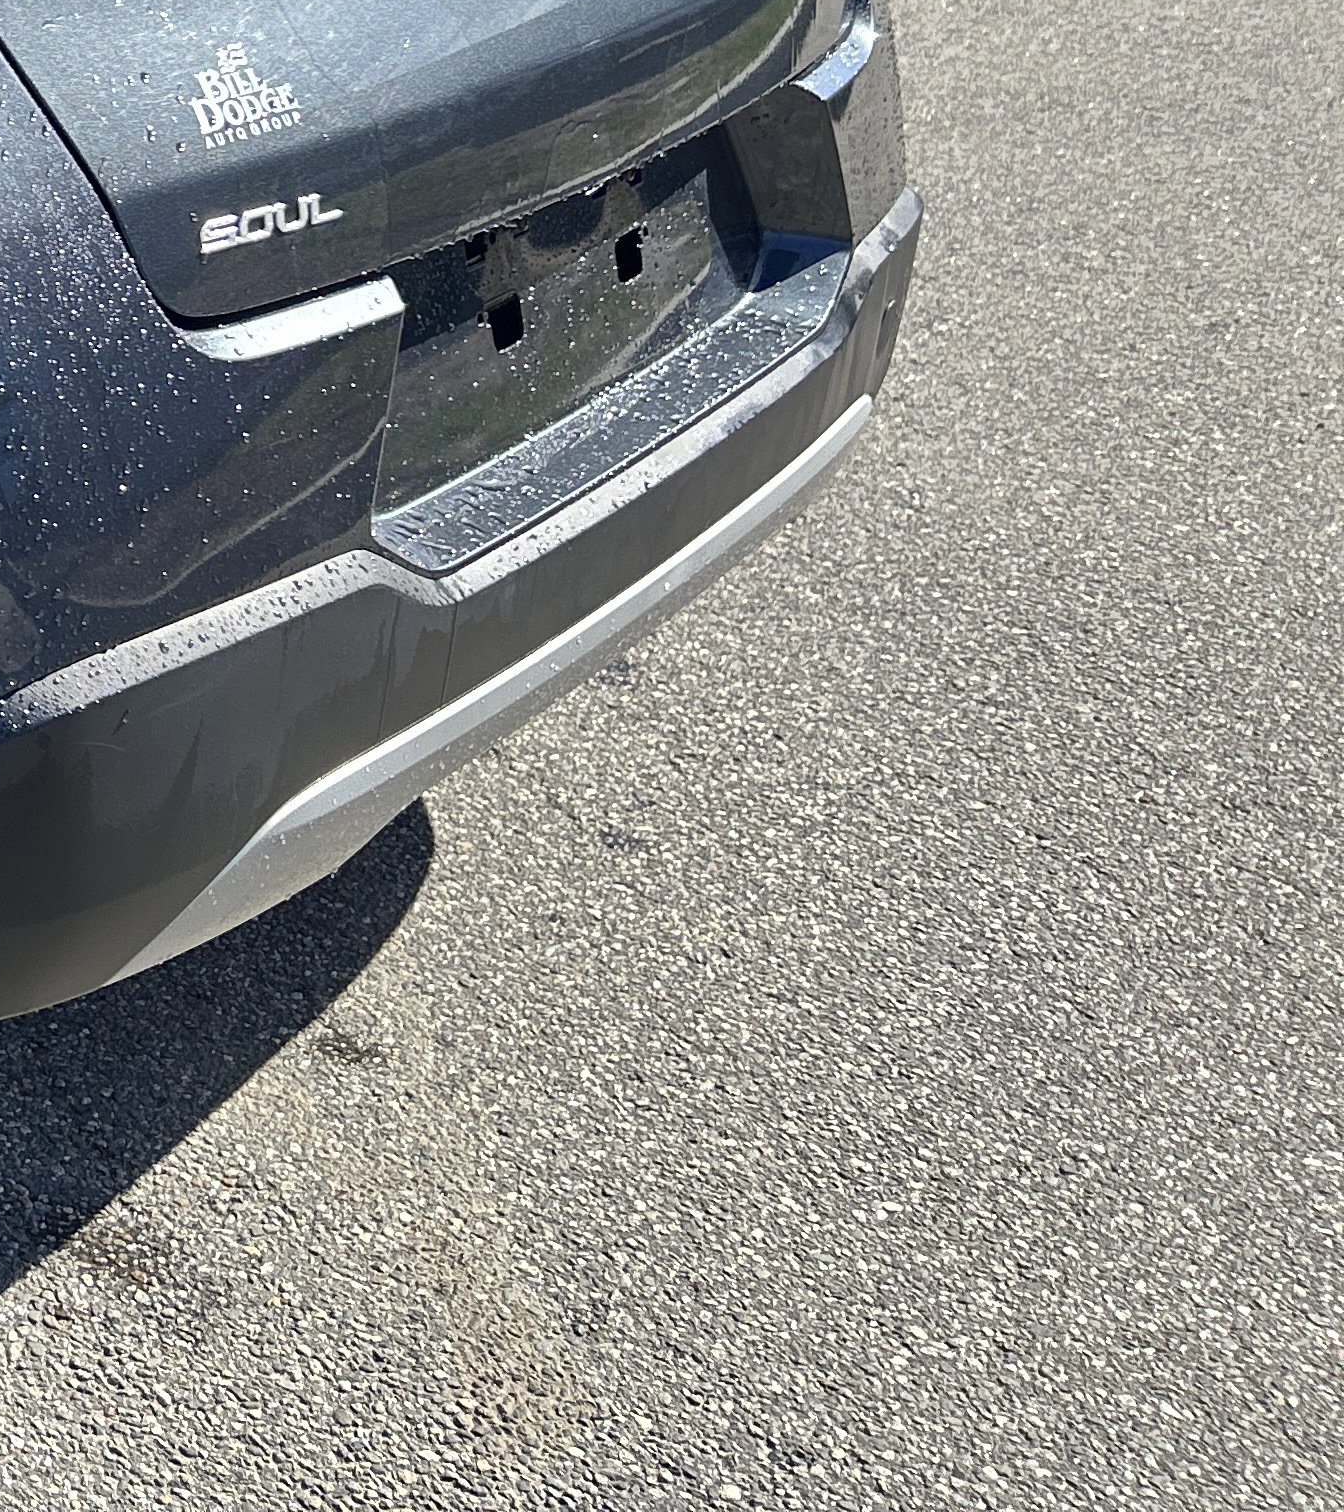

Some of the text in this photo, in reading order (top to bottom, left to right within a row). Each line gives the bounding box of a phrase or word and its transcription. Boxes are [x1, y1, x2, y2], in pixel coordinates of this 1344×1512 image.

[193, 67, 269, 104] BILL
[188, 82, 302, 135] DODGE
[204, 111, 302, 149] AUTO GROUP
[199, 192, 344, 255] SOUL
